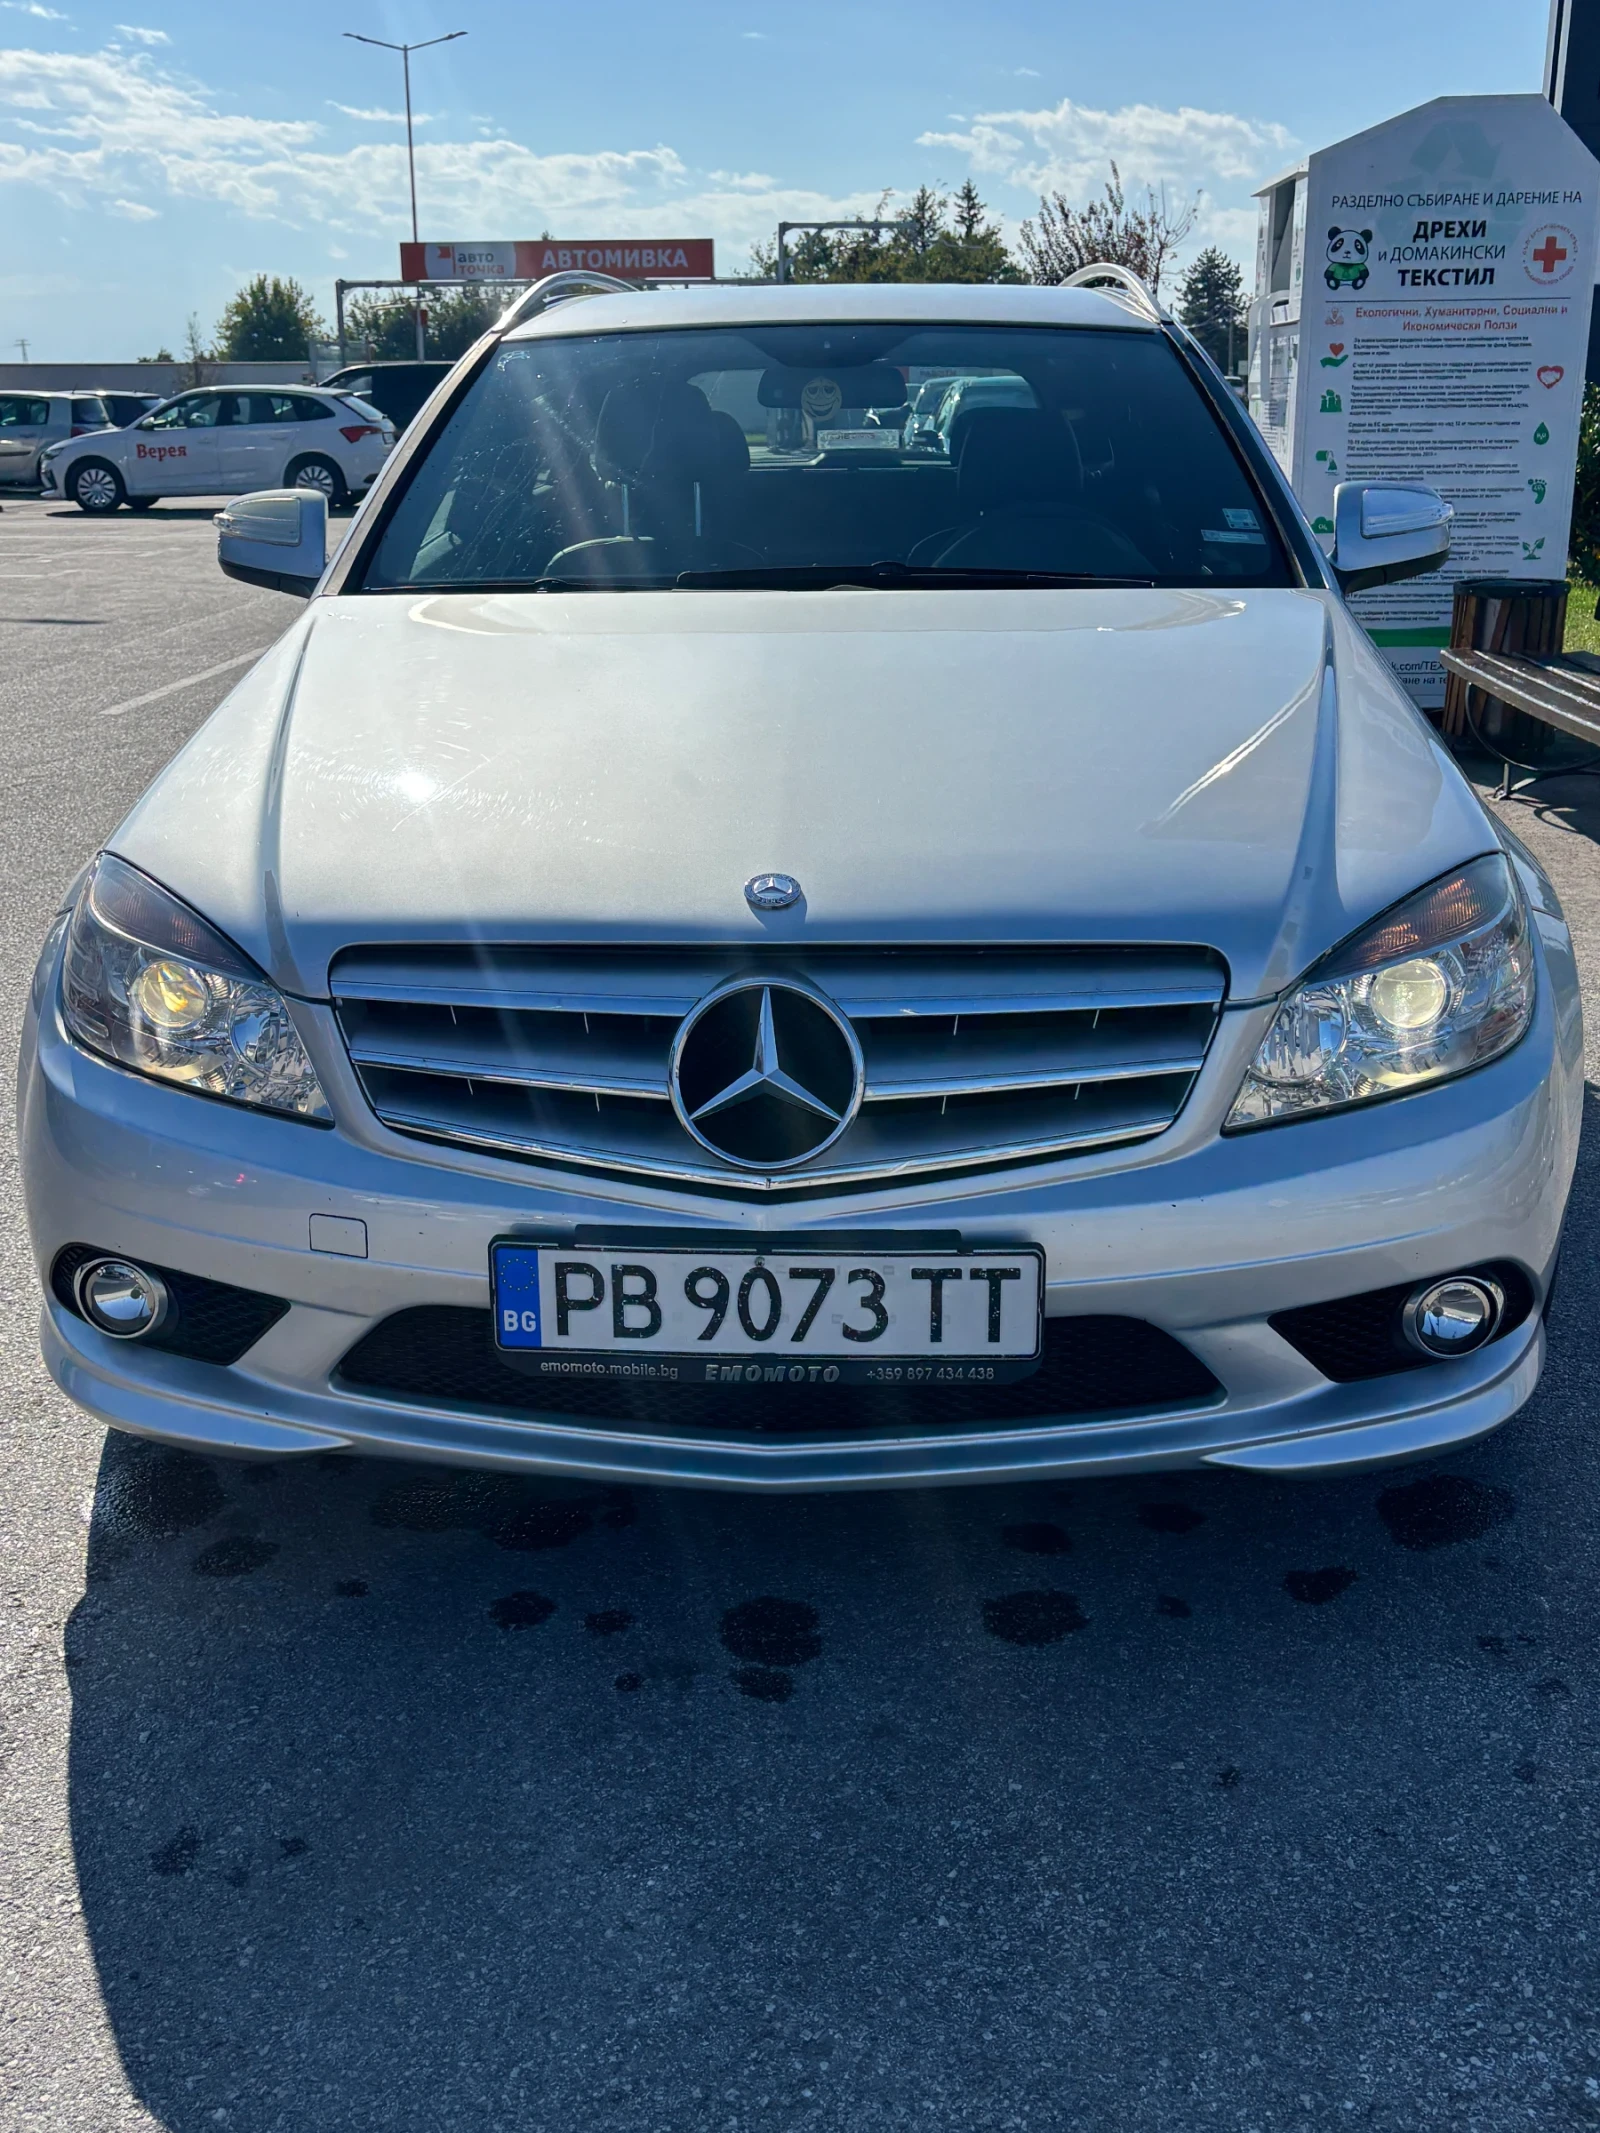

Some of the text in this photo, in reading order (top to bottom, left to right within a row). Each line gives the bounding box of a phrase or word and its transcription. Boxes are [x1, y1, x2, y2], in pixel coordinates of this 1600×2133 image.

[1332, 191, 1583, 209] РАЗДЕЛНО СЪБИРАНЕ И ДАРЕНИЕ НА
[1412, 220, 1487, 243] ДРЕХИ
[457, 252, 495, 264] авто
[542, 248, 689, 269] АВТОМИВКА
[1378, 245, 1506, 264] и ДОМАКИНСКИ
[457, 264, 505, 276] точка
[1398, 267, 1495, 287] ТЕКСТИЛ
[1503, 304, 1558, 316] Социални
[1561, 305, 1568, 315] и
[1402, 319, 1518, 332] Икономически Ползи
[136, 443, 187, 462] Верея
[554, 1262, 1021, 1343] PB 9073 TT
[503, 1309, 537, 1332] BG
[540, 1360, 679, 1379] emomoto.mobile.bg
[704, 1364, 840, 1383] EMOMOTO
[866, 1367, 995, 1380] +359 897 434 438
